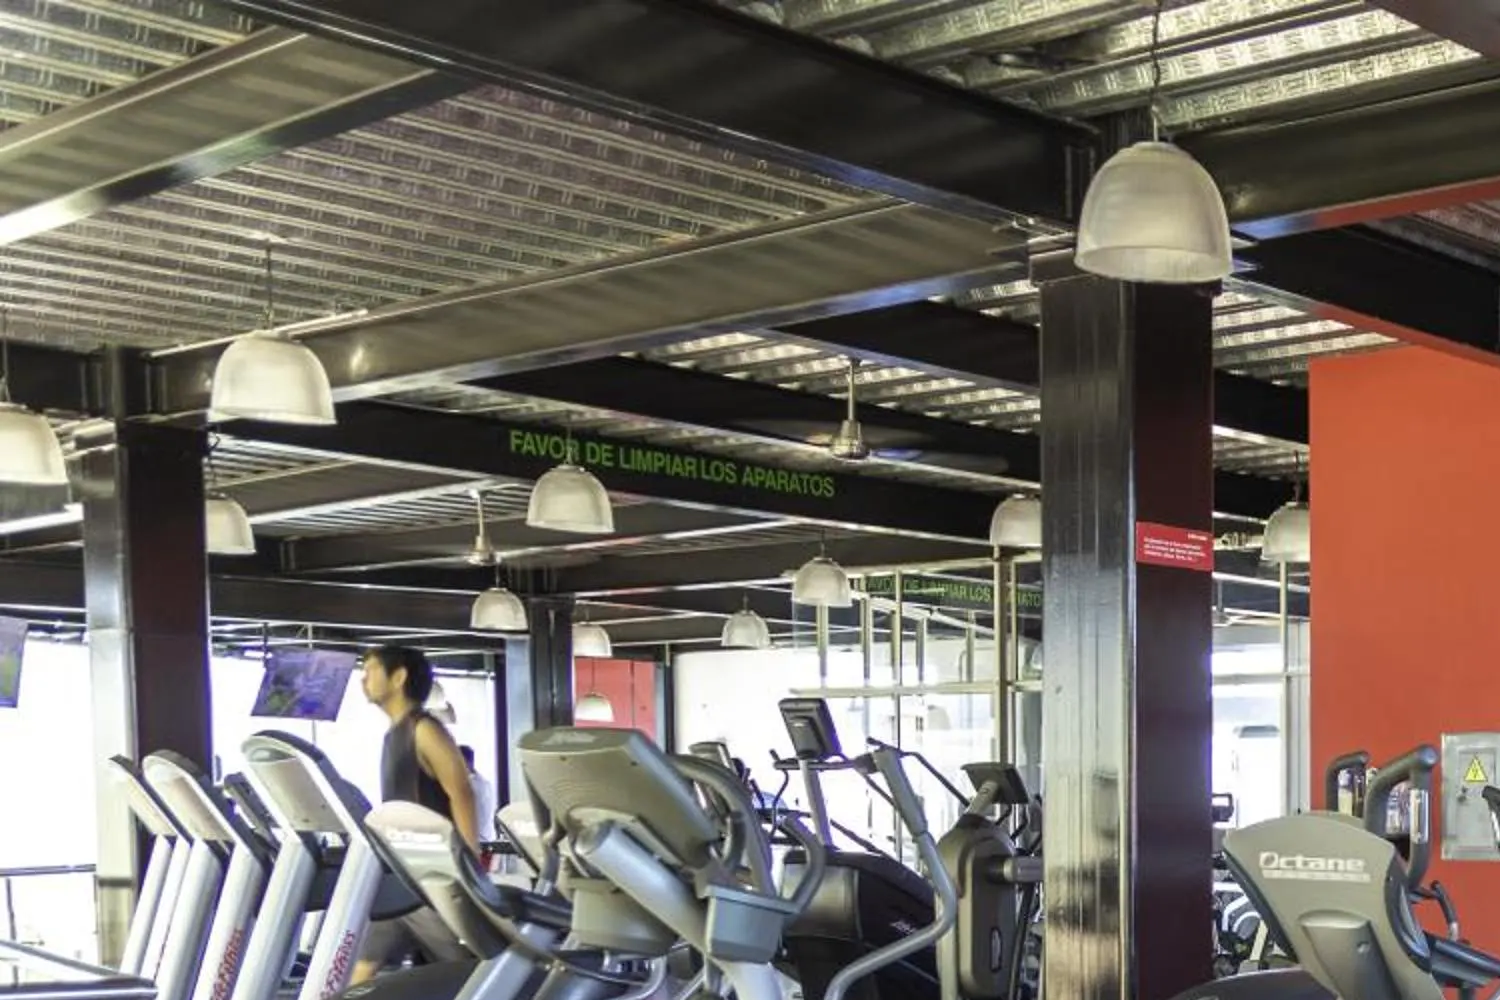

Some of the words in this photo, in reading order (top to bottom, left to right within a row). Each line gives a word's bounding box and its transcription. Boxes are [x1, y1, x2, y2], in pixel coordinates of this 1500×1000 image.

[510, 430, 580, 461] FAVOR
[586, 441, 614, 466] DE
[619, 448, 698, 479] LIMPIAR
[701, 459, 738, 484] LOS
[741, 465, 835, 497] APARATOS
[1259, 851, 1366, 872] Octane
